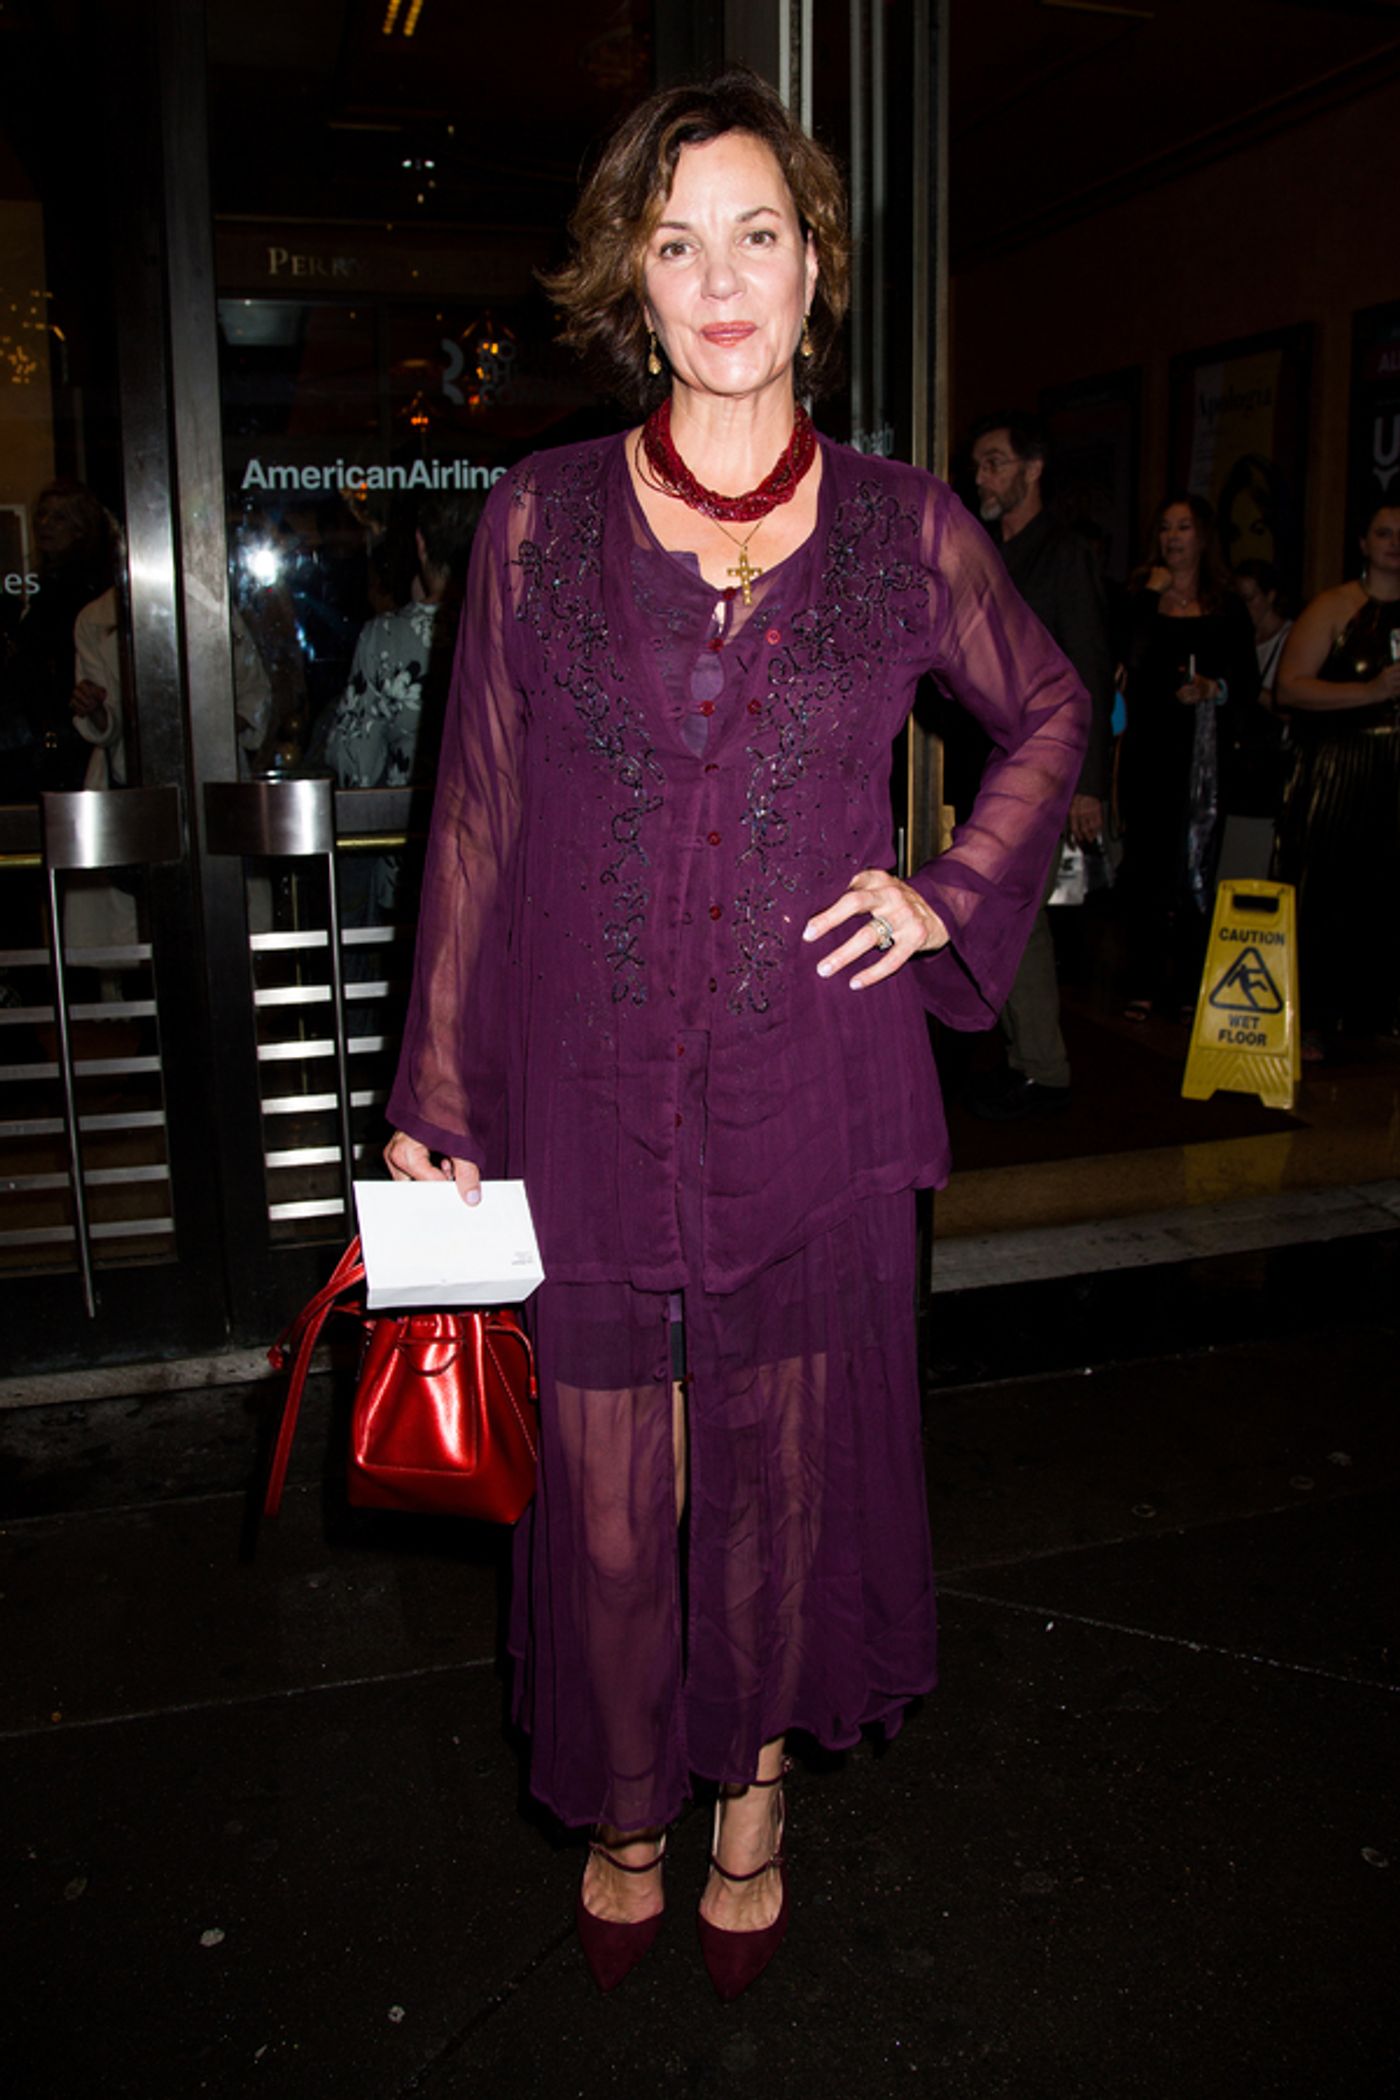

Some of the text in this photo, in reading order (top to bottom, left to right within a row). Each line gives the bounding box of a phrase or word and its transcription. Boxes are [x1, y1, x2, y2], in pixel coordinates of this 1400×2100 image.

[241, 458, 509, 490] AmericanAirline
[1218, 927, 1285, 946] CAUTION
[1228, 1013, 1260, 1028] WET
[1218, 1028, 1268, 1047] FLOOR
